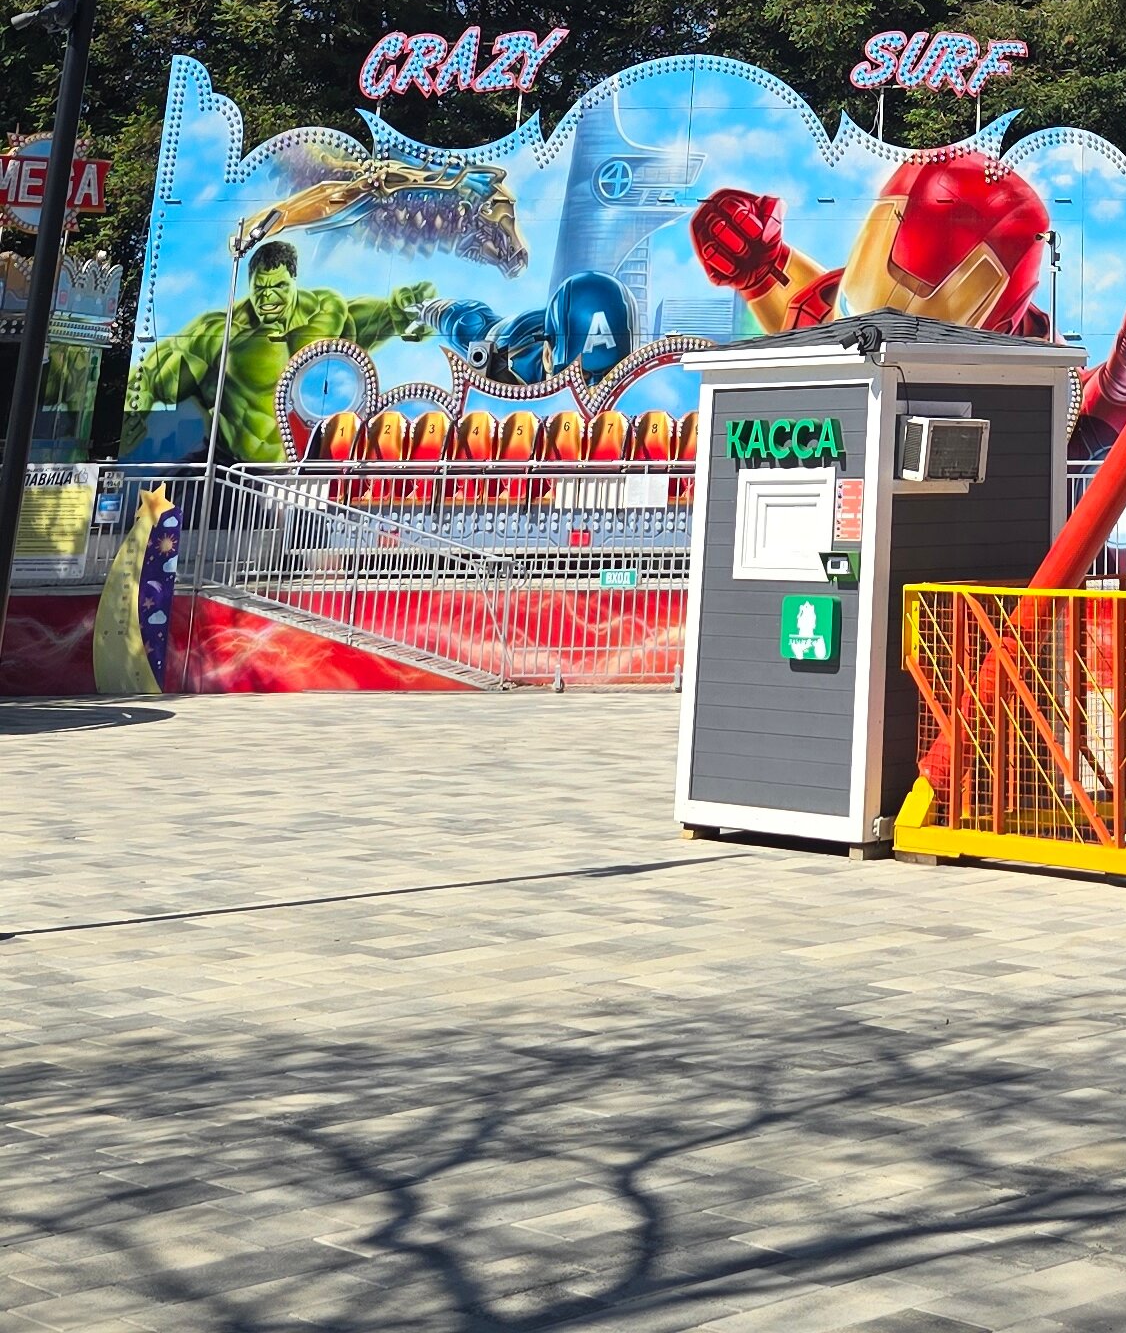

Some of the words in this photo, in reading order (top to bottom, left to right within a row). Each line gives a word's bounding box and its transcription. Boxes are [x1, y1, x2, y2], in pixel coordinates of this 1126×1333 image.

[360, 26, 570, 99] CRAZY
[850, 30, 1028, 98] SURF
[0, 159, 98, 206] MEA
[582, 311, 616, 354] A
[340, 427, 345, 437] 1
[384, 424, 391, 434] 2
[428, 424, 435, 434] 3
[472, 426, 479, 436] 4
[516, 425, 523, 436] 5
[563, 421, 570, 432] 6
[607, 423, 613, 434] 7
[651, 423, 658, 434] 8
[726, 418, 842, 459] КАССА
[605, 571, 631, 585] ВХОД
